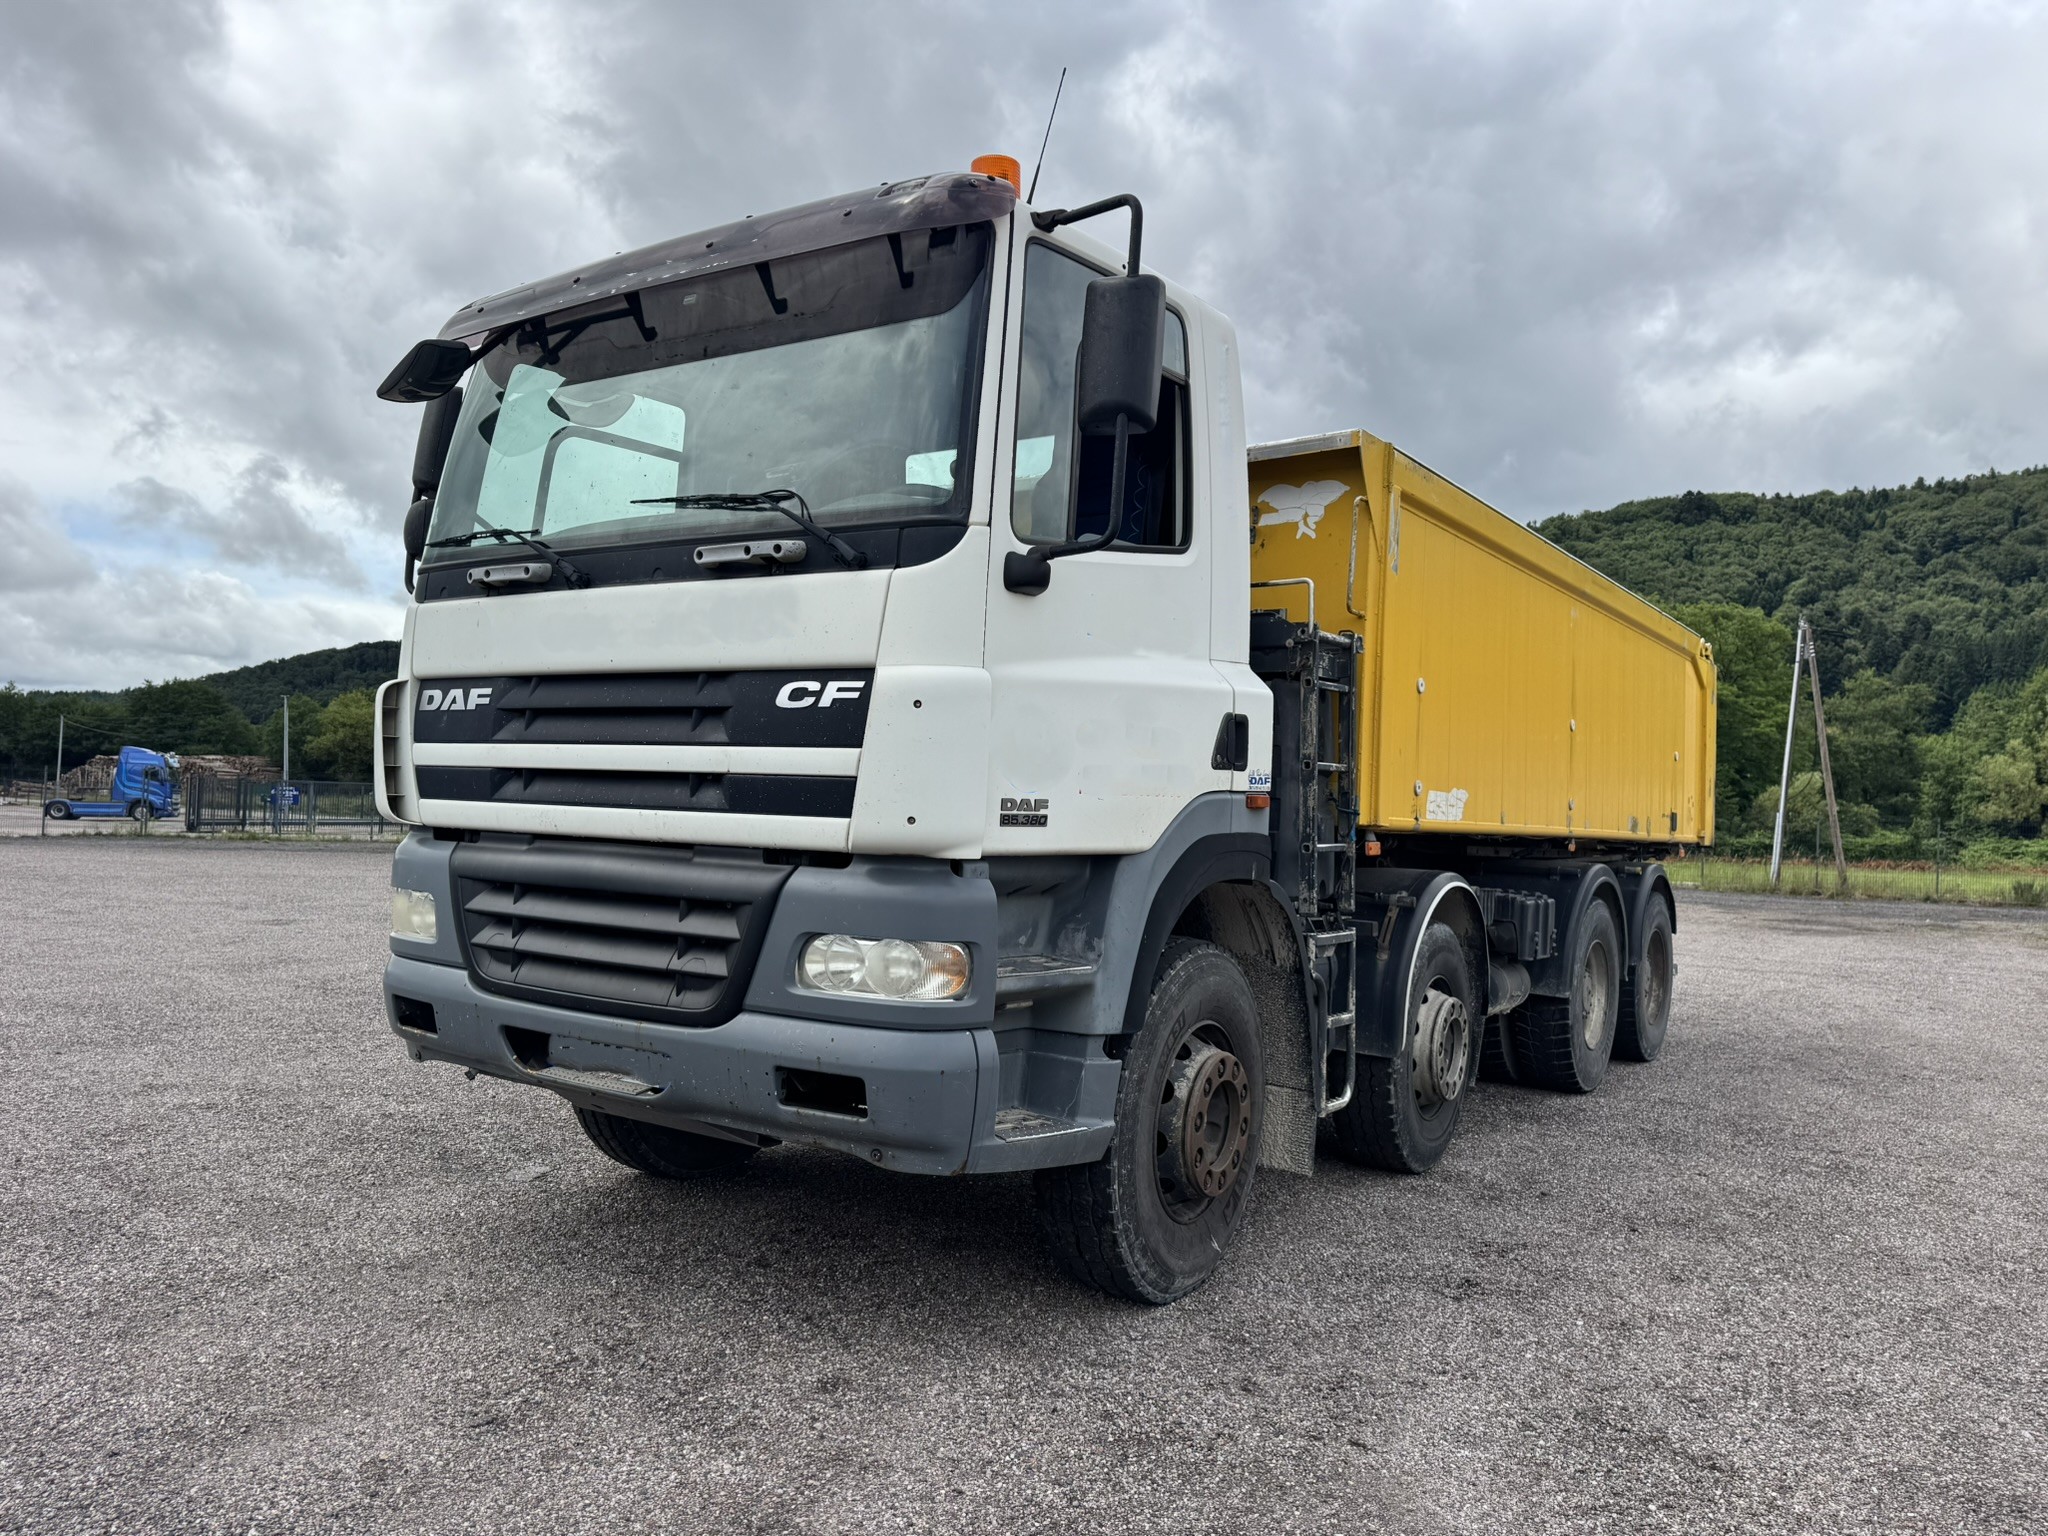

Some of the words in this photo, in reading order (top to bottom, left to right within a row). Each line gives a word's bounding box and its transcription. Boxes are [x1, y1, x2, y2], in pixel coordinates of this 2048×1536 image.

[419, 687, 493, 711] DAF
[775, 681, 866, 708] CF
[1250, 776, 1271, 786] DAF
[1001, 798, 1049, 812] DAF
[1001, 814, 1048, 826] 85.380
